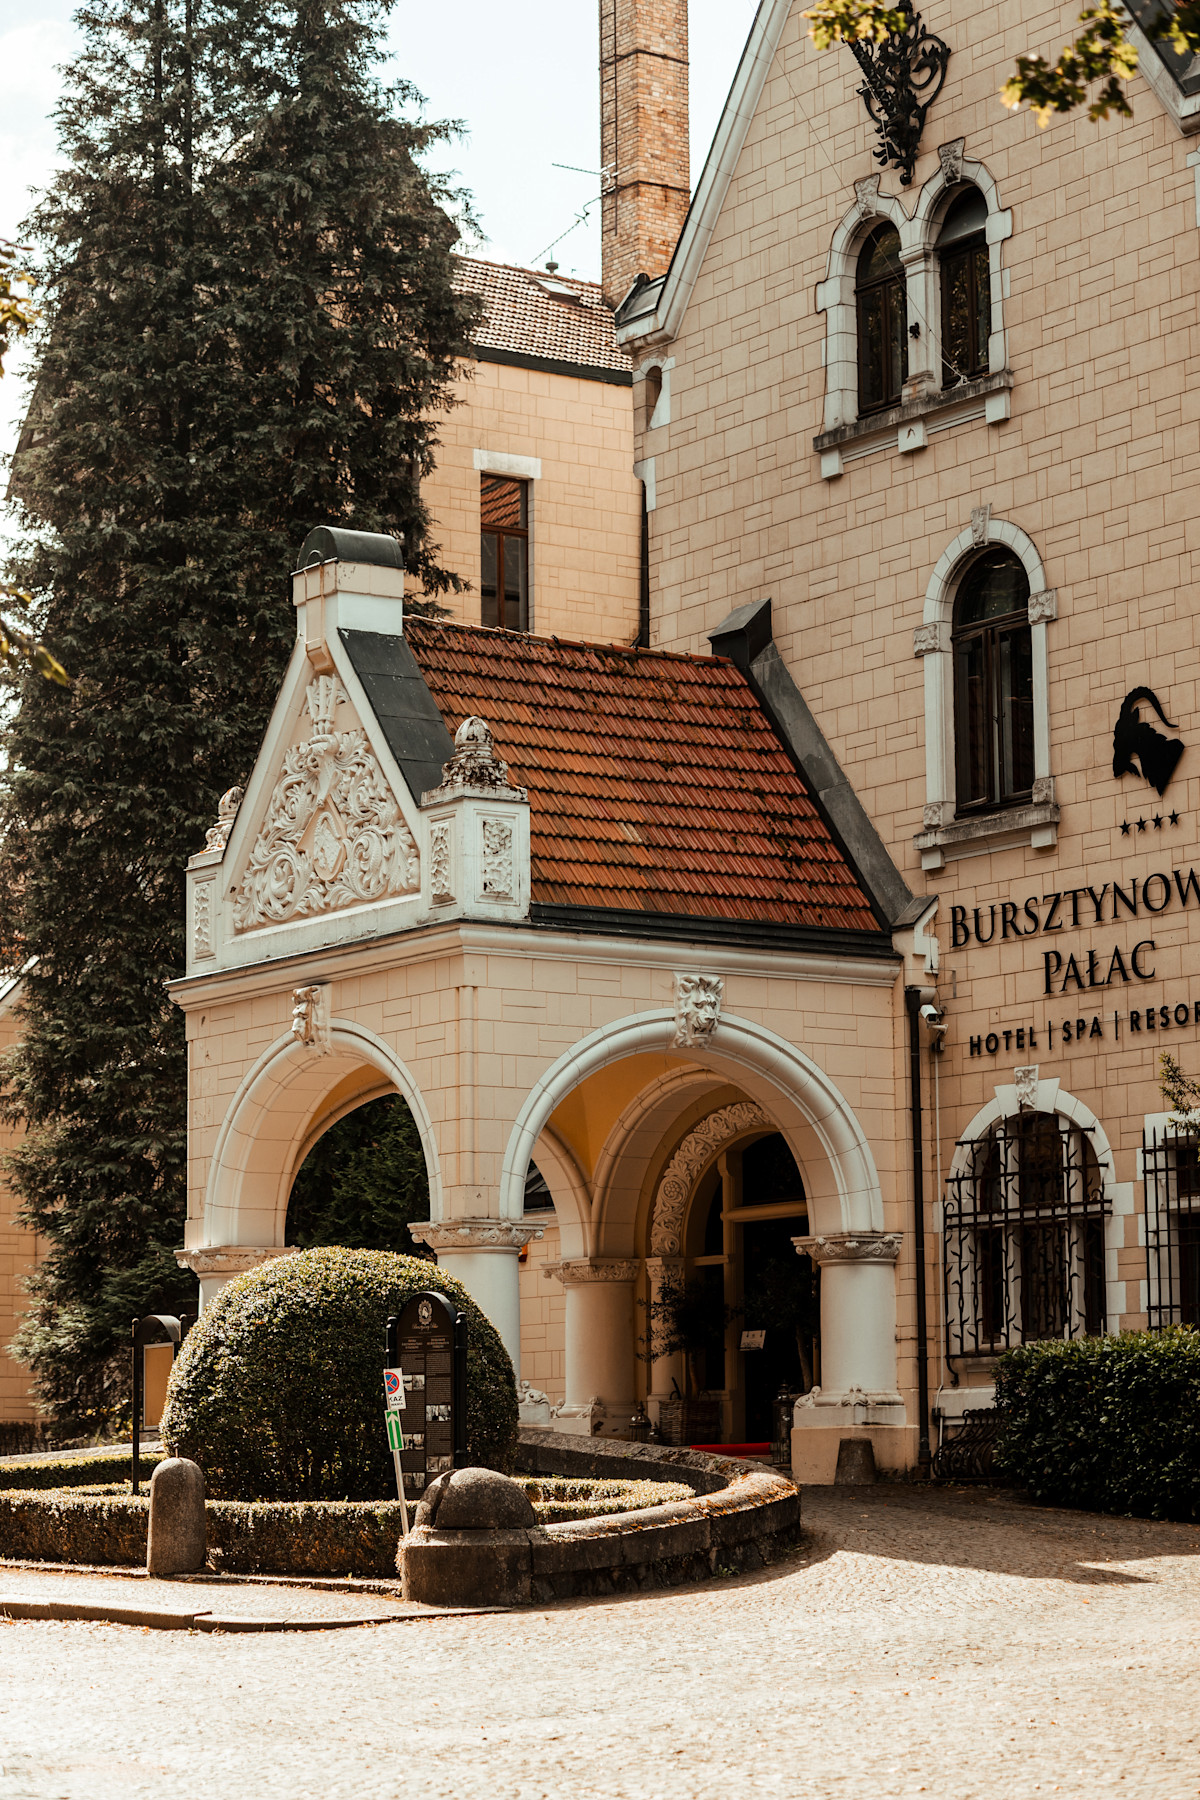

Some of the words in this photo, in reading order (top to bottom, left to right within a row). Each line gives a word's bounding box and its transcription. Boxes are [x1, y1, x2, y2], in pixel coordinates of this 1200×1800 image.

[1042, 940, 1157, 995] PAŁAC
[969, 1026, 1038, 1056] HOTEL
[1062, 1016, 1103, 1044] SPA
